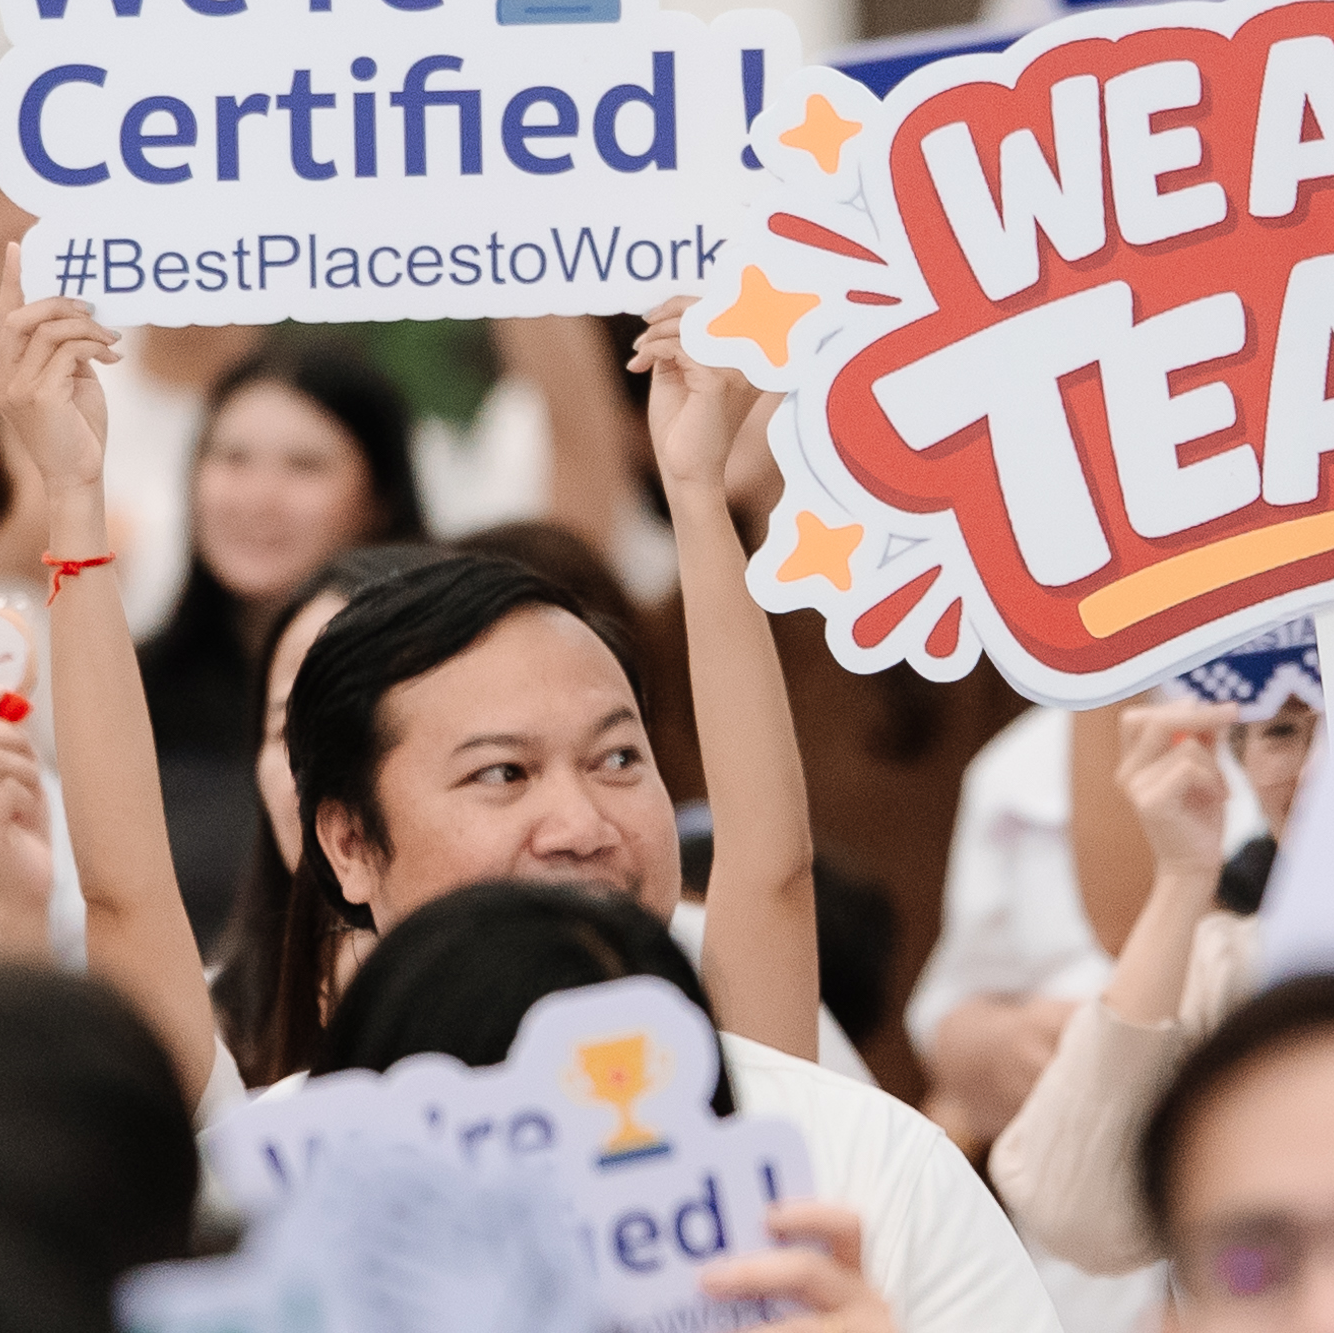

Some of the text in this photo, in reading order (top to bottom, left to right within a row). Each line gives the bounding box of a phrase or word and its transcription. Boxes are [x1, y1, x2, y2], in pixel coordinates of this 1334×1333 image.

[17, 51, 678, 187] Certified
[920, 60, 1228, 301] WE
[54, 224, 727, 298] #BestPlacestoWork
